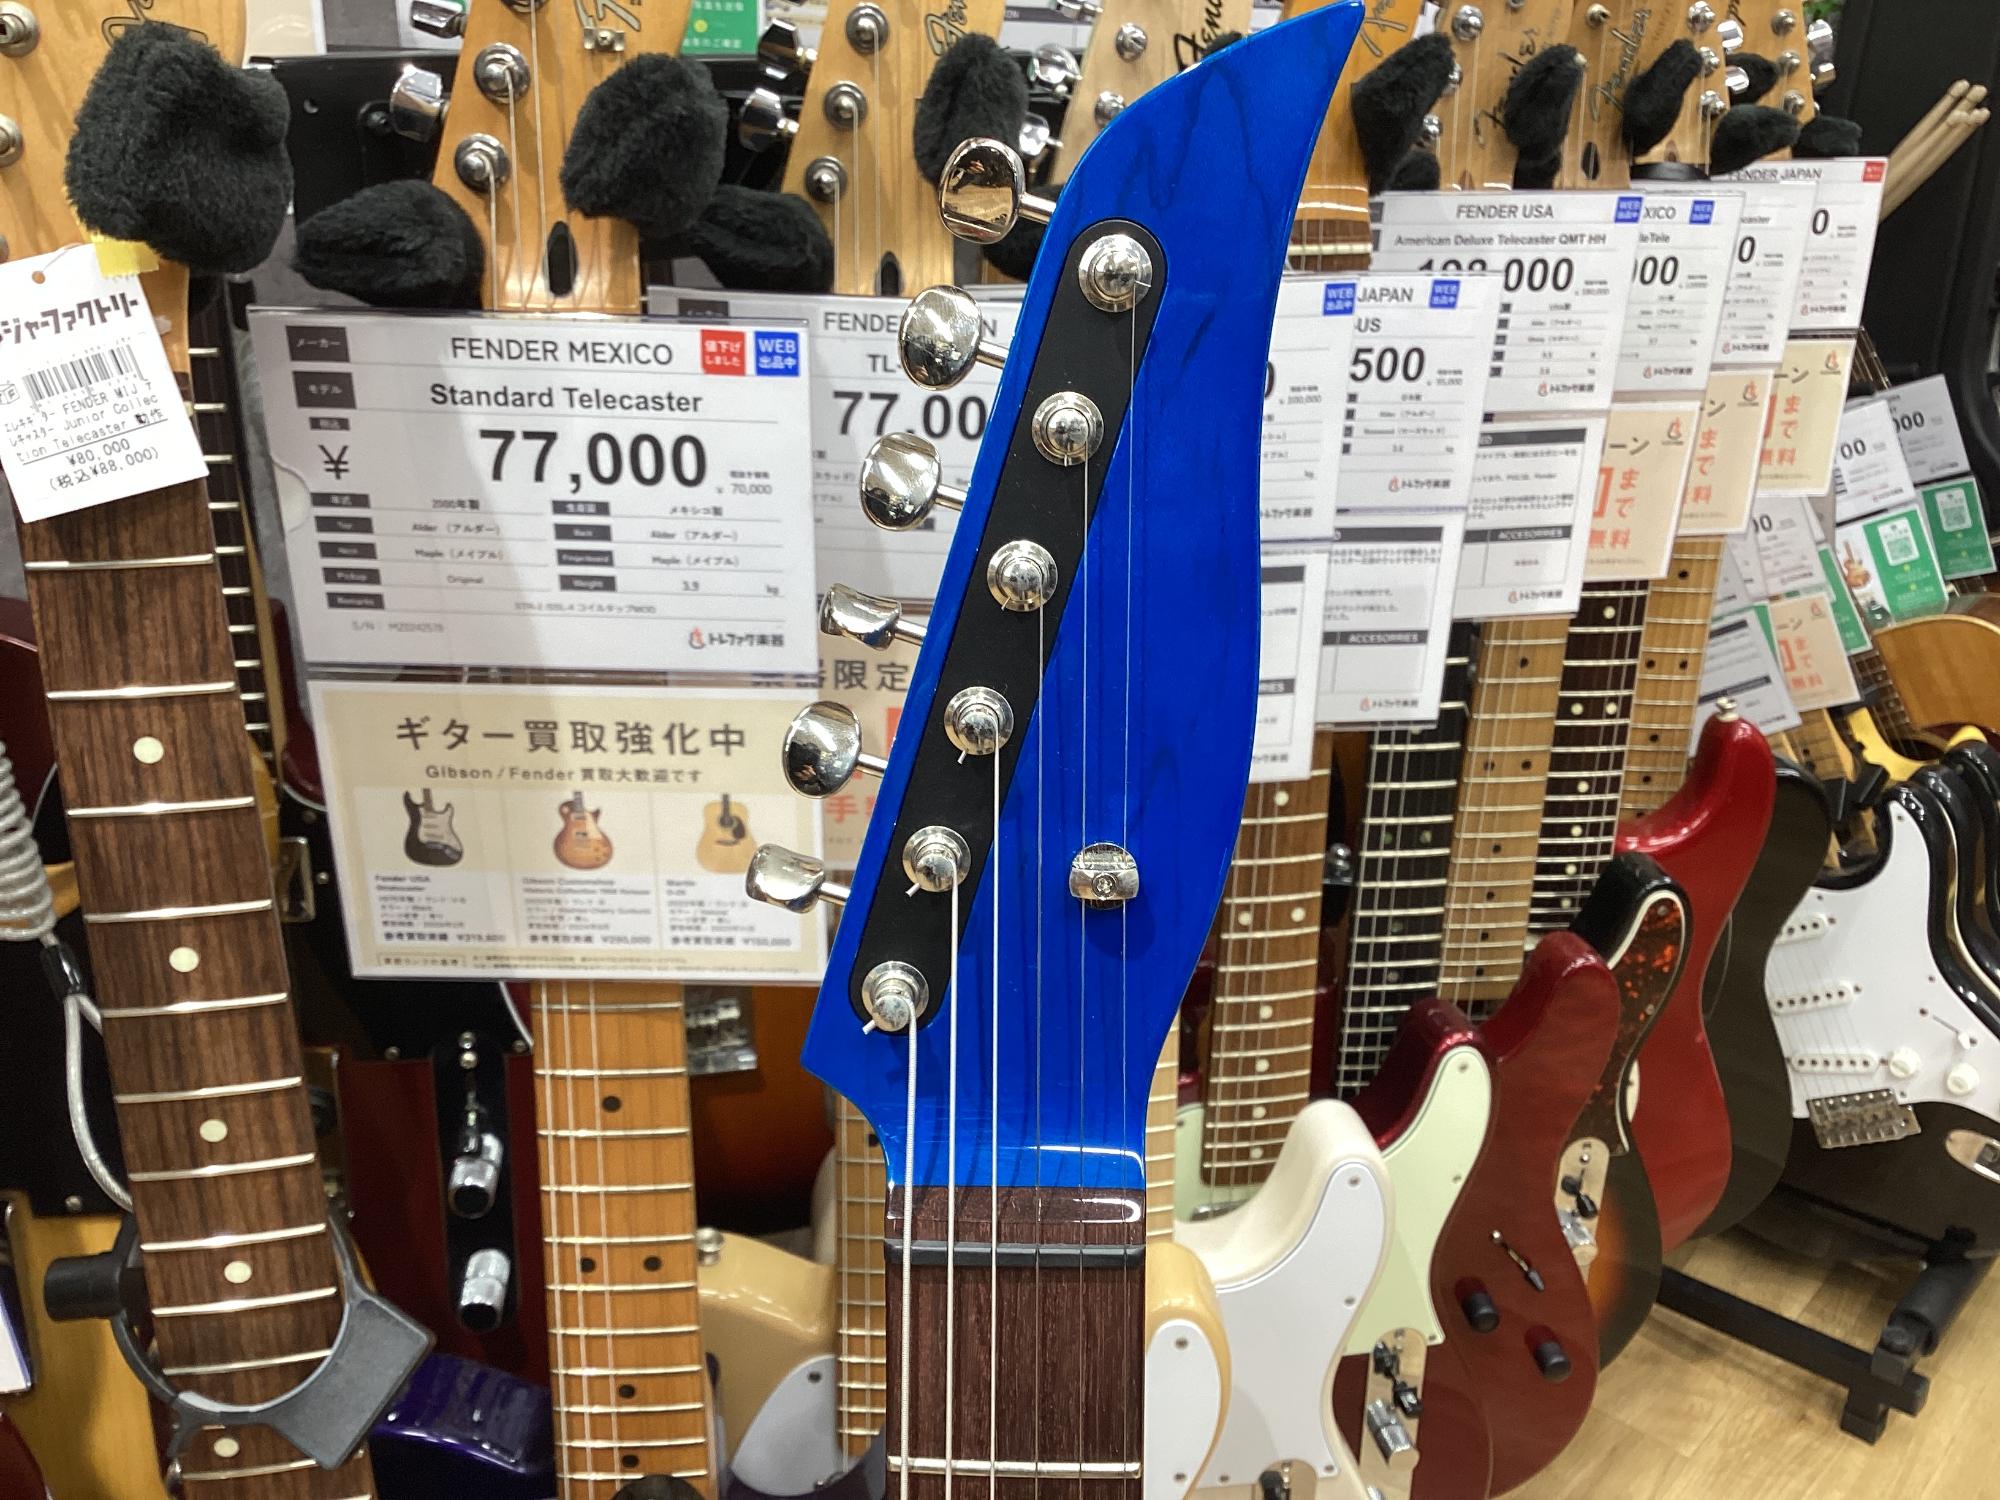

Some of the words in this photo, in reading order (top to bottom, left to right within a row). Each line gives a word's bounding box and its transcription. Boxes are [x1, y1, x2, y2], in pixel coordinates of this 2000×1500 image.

[1456, 204, 1518, 219] FENDER
[1522, 204, 1554, 218] USA
[1644, 206, 1677, 219] XICO
[1395, 234, 1450, 247] American
[1454, 234, 1493, 246] Deluxe
[1498, 233, 1556, 246] Telecaster
[1558, 233, 1586, 245] QMT
[1588, 233, 1606, 245] HH
[1632, 255, 1680, 285] 00
[1358, 287, 1414, 303] JAPAN
[0, 291, 139, 344] ジャーファクトリー
[824, 311, 899, 333] FENDE
[451, 336, 558, 362] FENDER
[568, 341, 673, 365] MEXICO
[758, 338, 797, 354] WEB
[704, 355, 741, 367] しました
[758, 355, 797, 369] 出品中
[866, 353, 902, 373] TL-
[62, 391, 109, 415] FENDER
[430, 383, 554, 408] Standard
[562, 387, 703, 413] Telecaster
[64, 409, 106, 431] Junior
[112, 394, 159, 415] Collec
[833, 390, 988, 441] 77,00
[16, 445, 48, 463] tion
[53, 420, 127, 450] Telecaster
[66, 437, 131, 466] ¥80,000
[317, 444, 350, 480] ¥
[478, 429, 708, 494] 77,000
[731, 483, 773, 496] 70,000
[708, 632, 785, 648] トレファク楽器
[395, 716, 747, 758] ギター買取強化中
